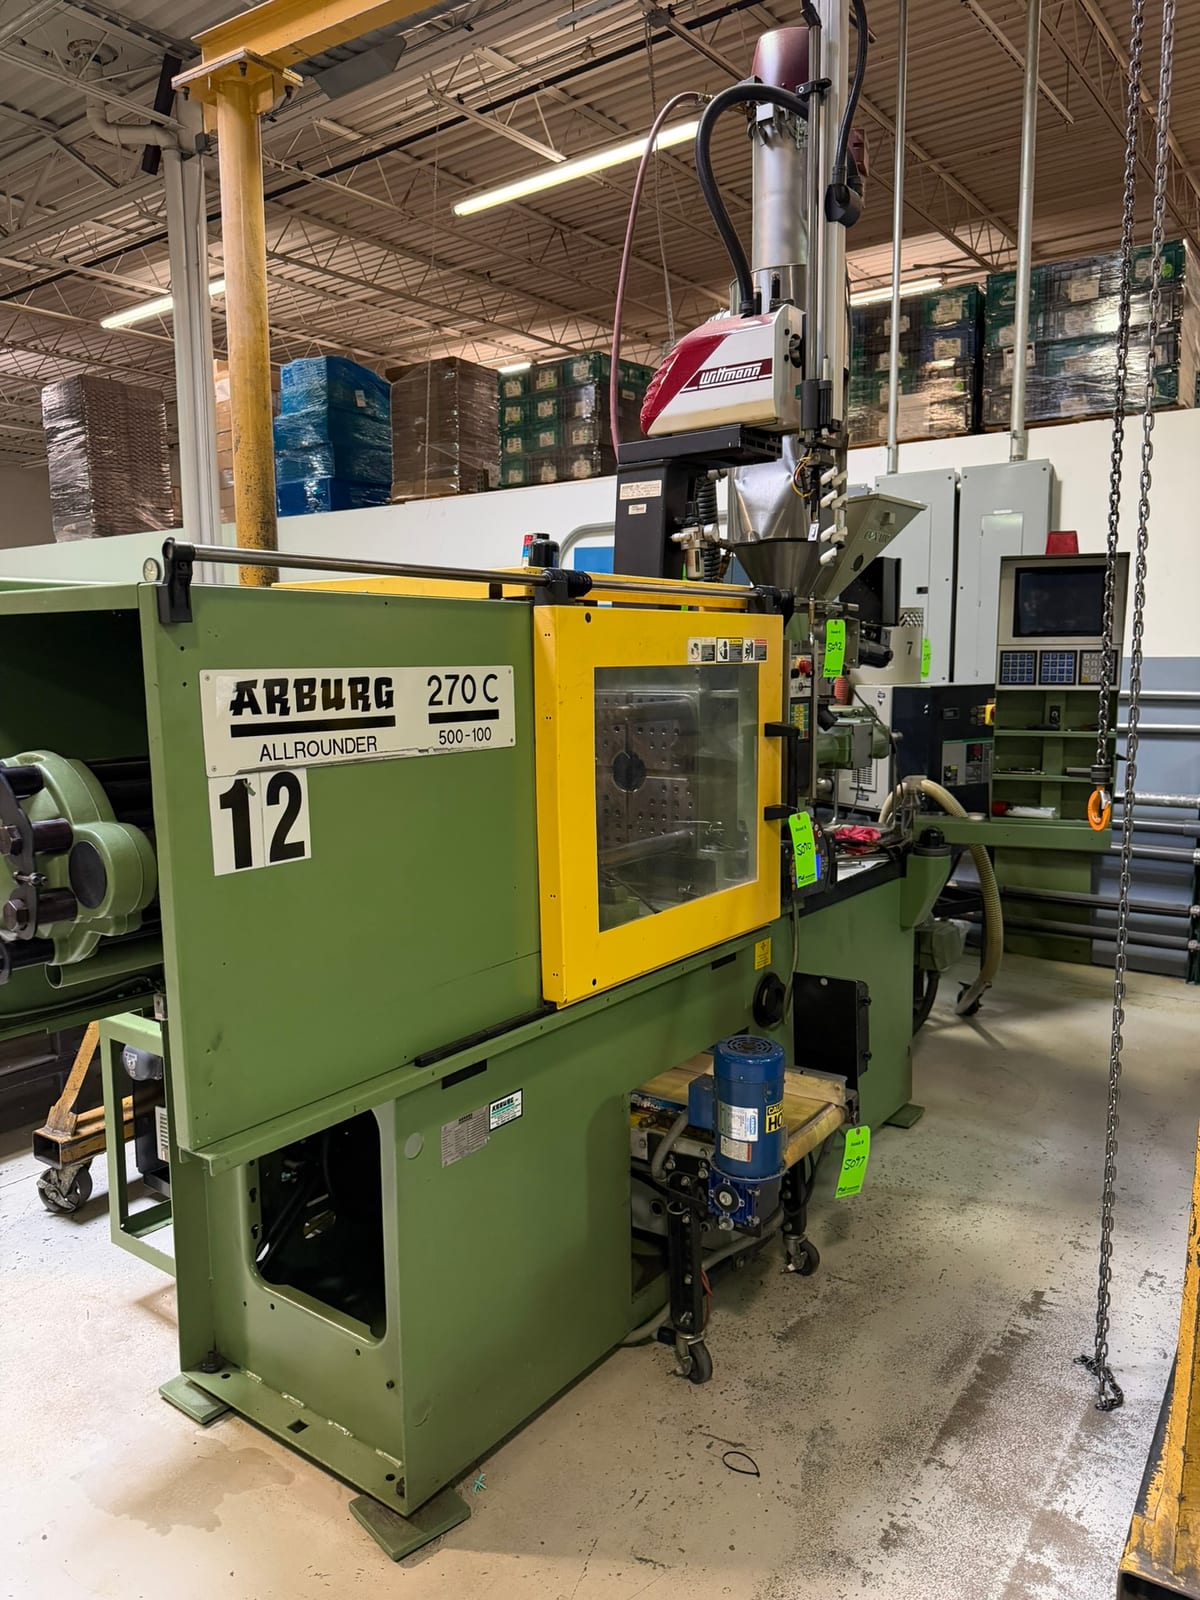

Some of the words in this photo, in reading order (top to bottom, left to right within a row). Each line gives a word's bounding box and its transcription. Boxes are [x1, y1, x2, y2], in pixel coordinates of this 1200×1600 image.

[699, 362, 762, 384] Wittmann
[906, 640, 913, 656] 7
[229, 676, 395, 717] ARBURG
[427, 674, 477, 706] 270
[259, 735, 378, 762] ALLROUNDER
[438, 726, 492, 745] 500-100
[219, 771, 305, 870] 12
